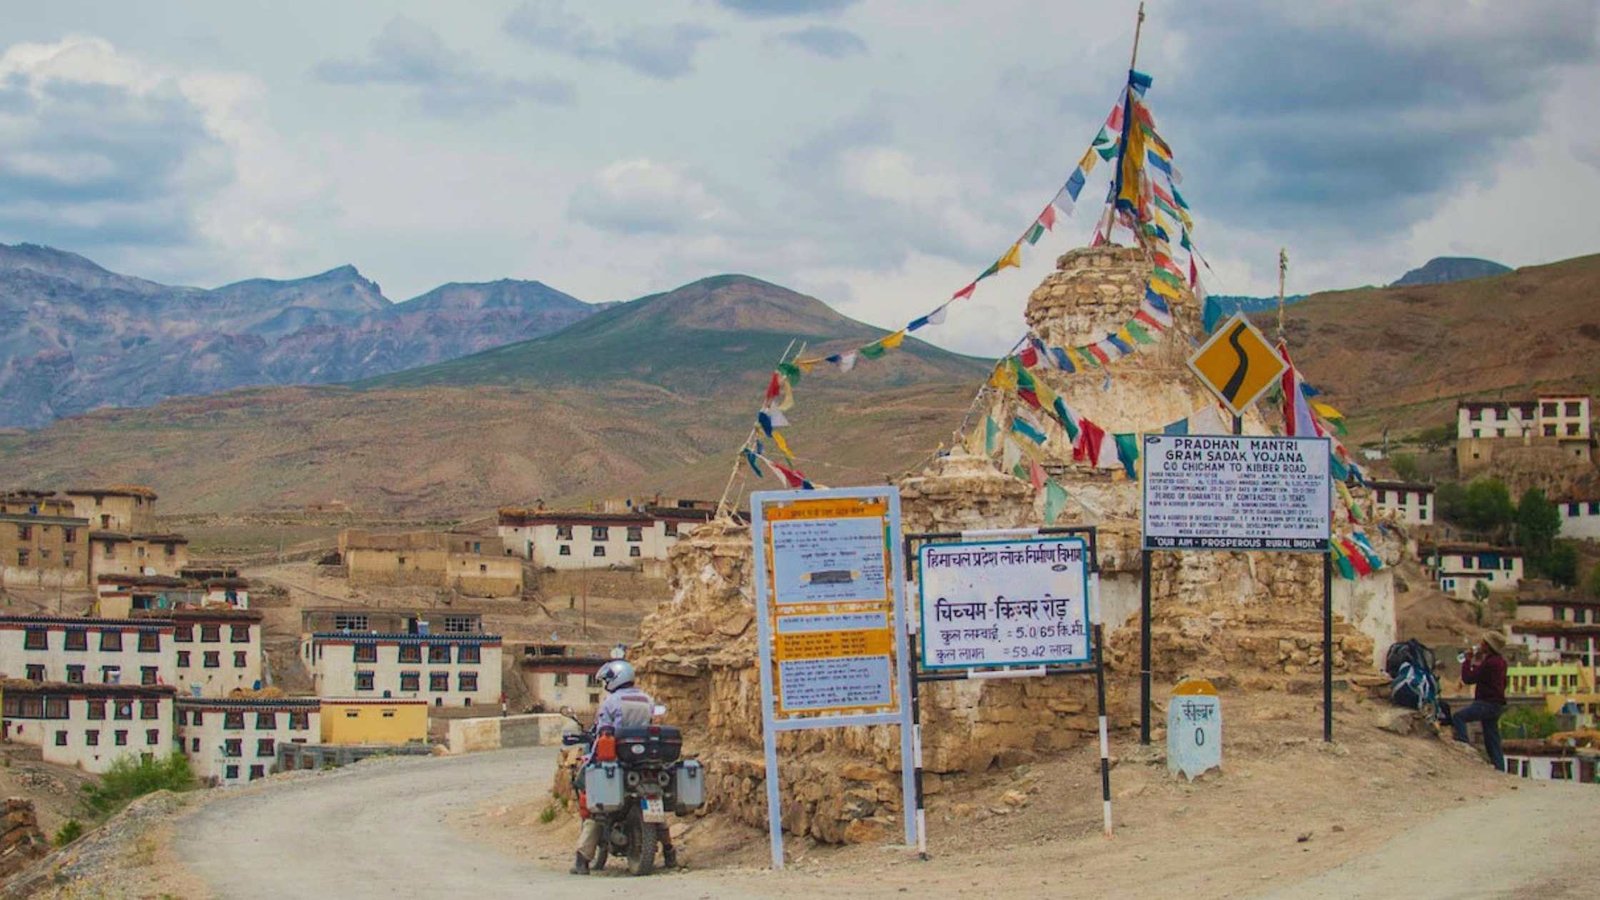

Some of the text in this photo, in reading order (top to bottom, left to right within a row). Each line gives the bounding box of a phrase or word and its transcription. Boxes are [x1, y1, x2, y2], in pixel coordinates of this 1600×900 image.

[1174, 438, 1298, 451] PRADHAN MANTRI
[1165, 450, 1304, 463] GRAM SADAK YOJANA
[1182, 461, 1225, 473] CHICHAM
[1230, 463, 1242, 473] TO
[1246, 463, 1280, 473] KIBBER
[1283, 464, 1307, 474] ROAD
[1178, 538, 1194, 547] AIM
[1201, 538, 1261, 548] PROSPEROUS
[1265, 539, 1292, 548] RURAL
[926, 548, 971, 569] हिमाचल
[971, 546, 998, 568] प्रदेश
[999, 545, 1025, 565] लोक
[1025, 543, 1056, 564] निर्माण
[939, 629, 961, 646] कुल
[935, 649, 956, 664] कुल
[958, 647, 985, 660] लागत
[1012, 645, 1046, 658] 59.42
[1048, 643, 1073, 656] लाख
[1195, 727, 1205, 747] 0
